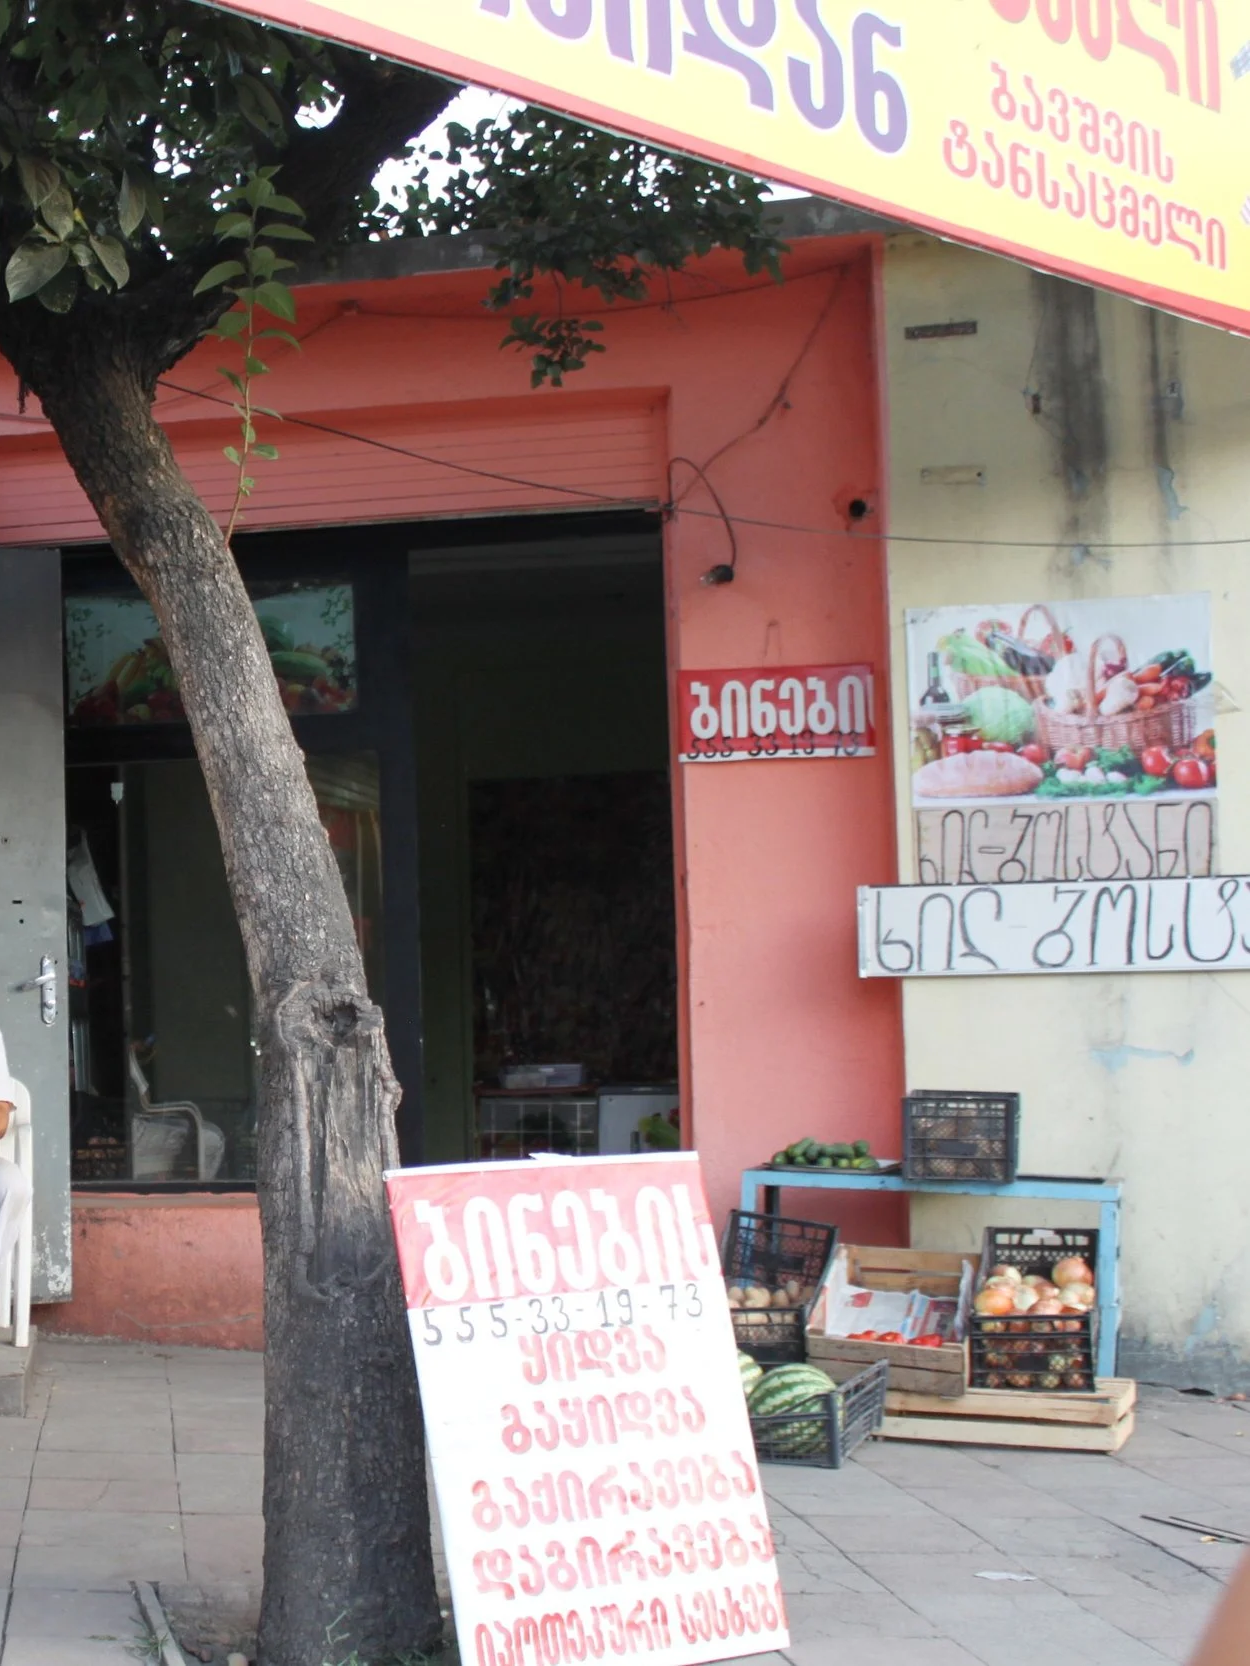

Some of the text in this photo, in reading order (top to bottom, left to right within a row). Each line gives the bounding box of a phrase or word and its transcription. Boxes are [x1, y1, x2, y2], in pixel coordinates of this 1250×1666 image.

[991, 61, 1174, 183] ბავშვის
[943, 119, 1226, 270] ტანსაცმელი
[414, 1184, 722, 1302] ბინების
[518, 1324, 667, 1385] ყიდვა
[501, 1385, 706, 1454] გაყიდვა
[472, 1514, 777, 1600] დაგირავება
